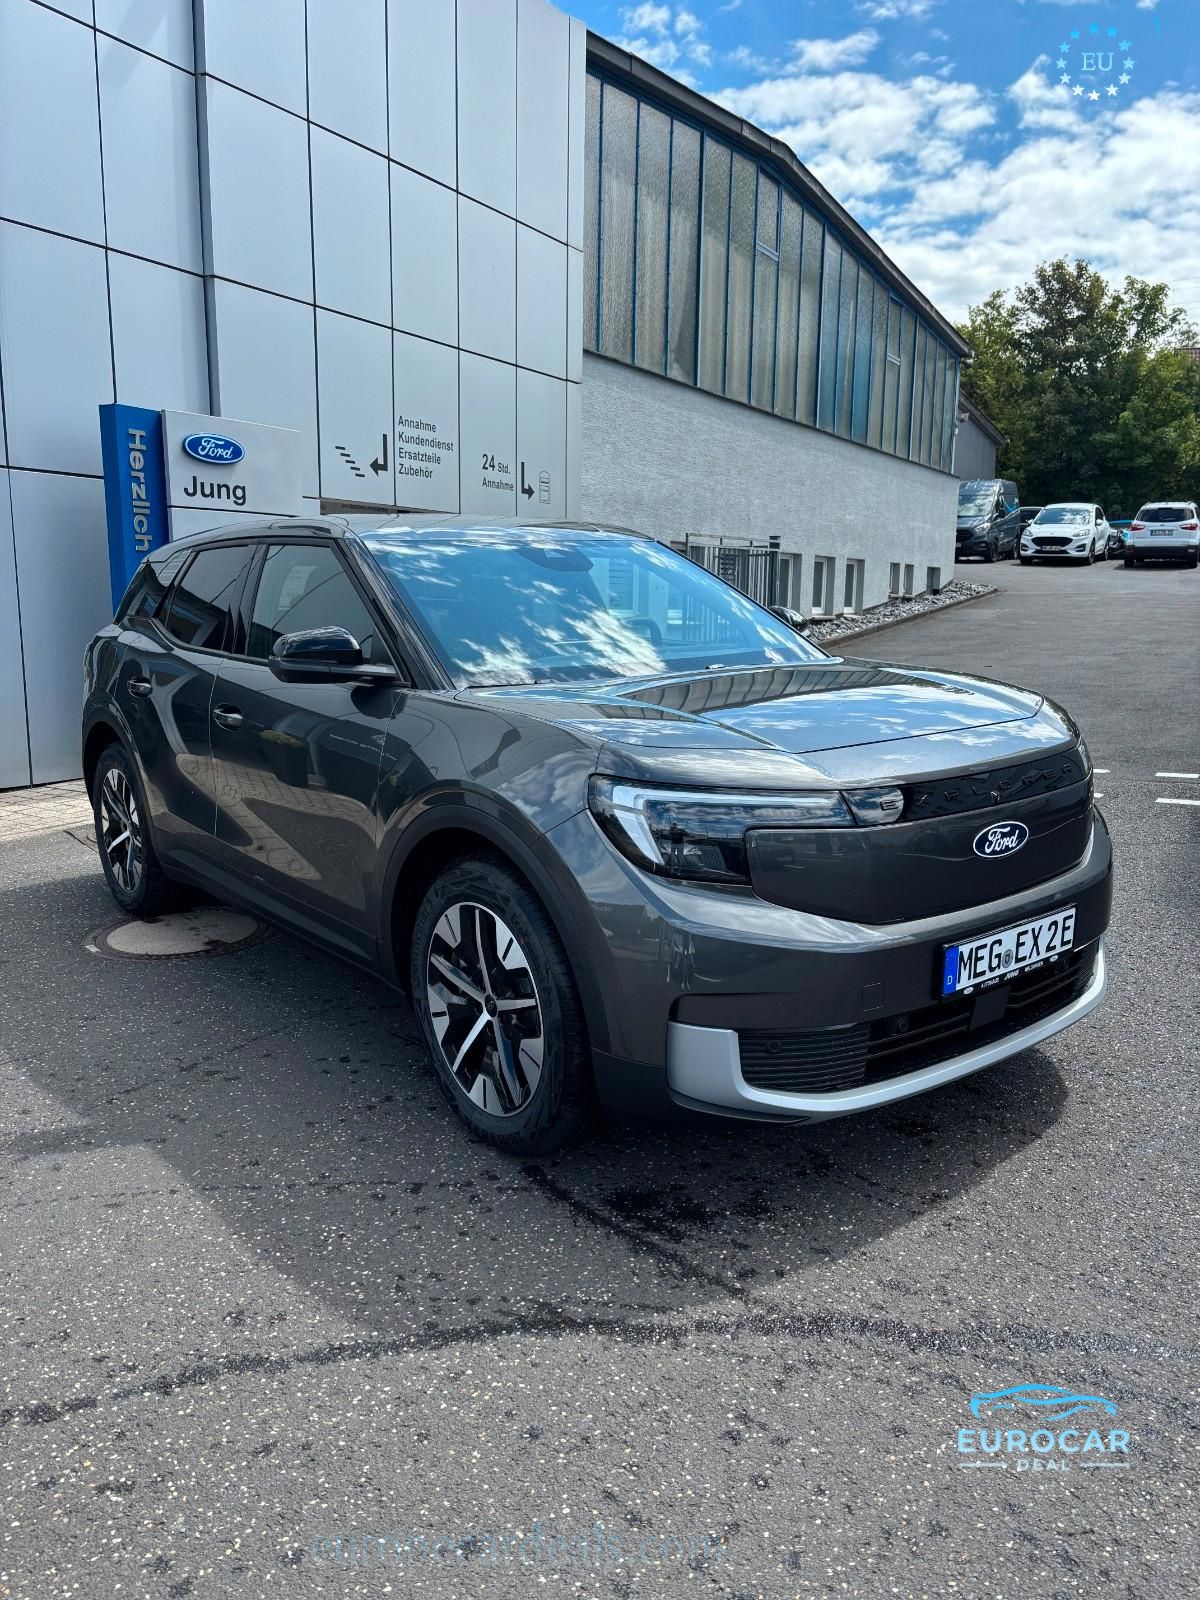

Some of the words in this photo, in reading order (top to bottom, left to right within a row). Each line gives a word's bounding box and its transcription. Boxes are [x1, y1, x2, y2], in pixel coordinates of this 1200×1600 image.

[398, 415, 437, 433] Annahme
[398, 431, 454, 452] Kundendienst
[398, 447, 442, 465] Ersatzteile
[482, 453, 496, 471] 24
[497, 462, 511, 475] Std.
[398, 463, 434, 479] Zubehör
[128, 428, 153, 552] Herzlich
[183, 475, 247, 506] Jung
[481, 476, 514, 492] Annahme
[957, 938, 1003, 984] MEG
